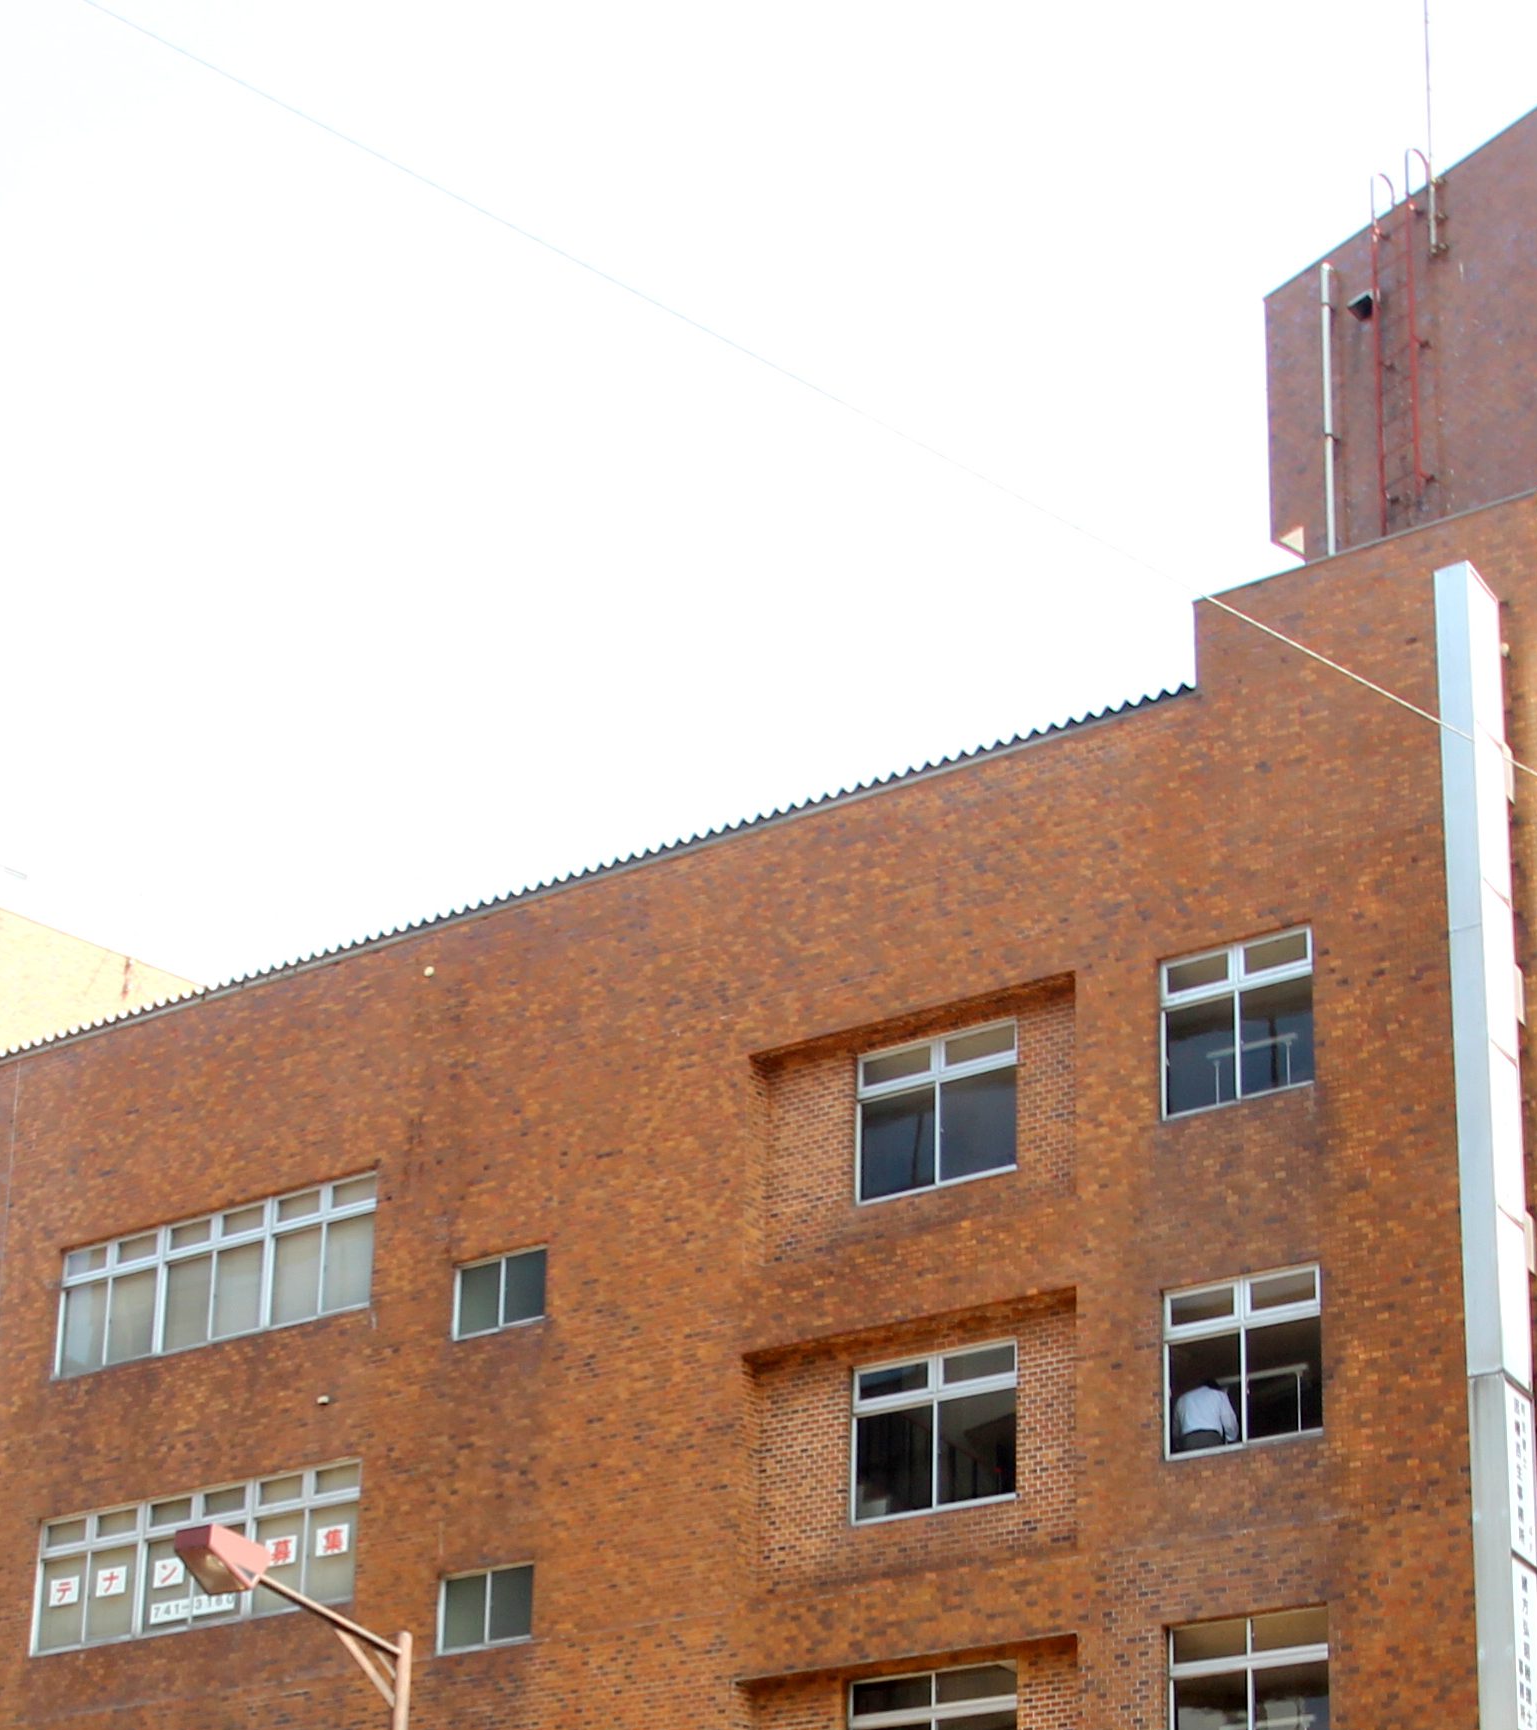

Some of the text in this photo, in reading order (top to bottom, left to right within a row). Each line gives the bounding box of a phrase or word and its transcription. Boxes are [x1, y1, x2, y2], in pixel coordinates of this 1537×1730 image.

[56, 1528, 343, 1602] テナン募集
